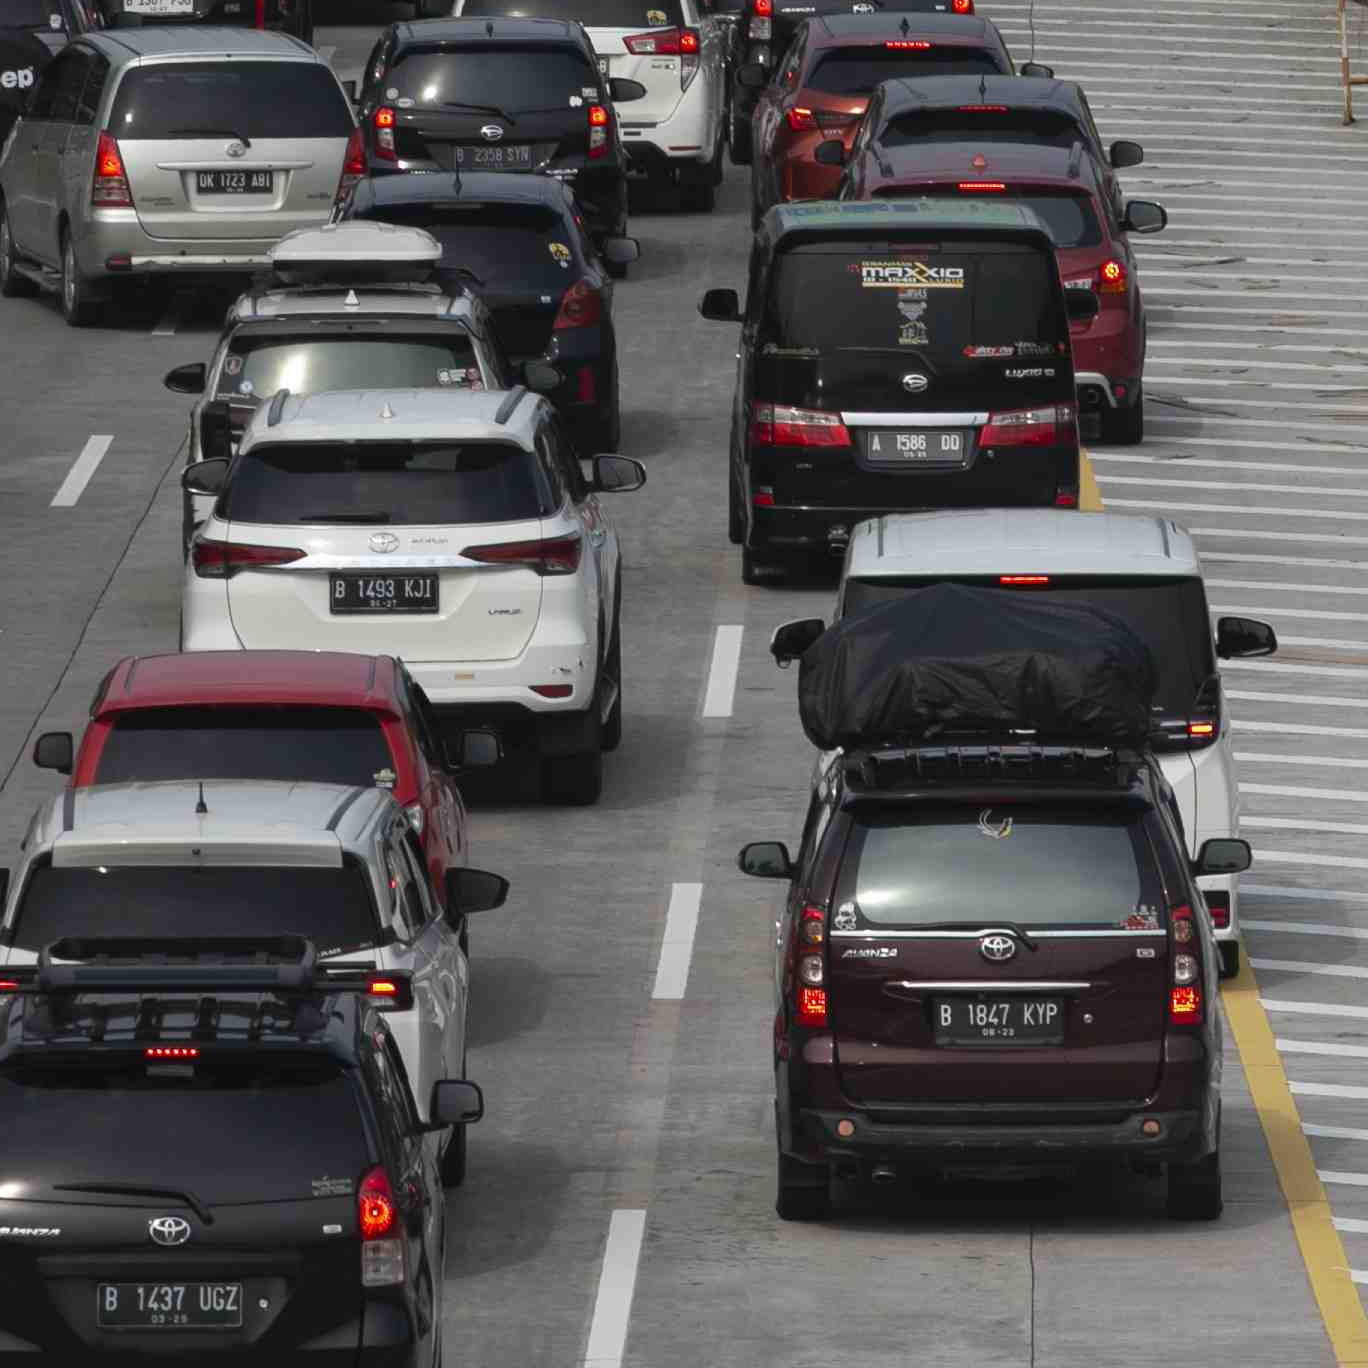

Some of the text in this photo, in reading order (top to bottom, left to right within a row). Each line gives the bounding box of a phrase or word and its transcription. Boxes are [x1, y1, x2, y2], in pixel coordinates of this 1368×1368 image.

[457, 147, 464, 162] B
[199, 171, 215, 188] DK
[220, 170, 246, 188] 1723
[872, 435, 881, 451] A
[896, 434, 927, 451] 1586
[335, 579, 431, 599] B 1493 KJI
[940, 1003, 1058, 1026] B 1847 KYP
[104, 1286, 239, 1311] B 1437 UGZ
